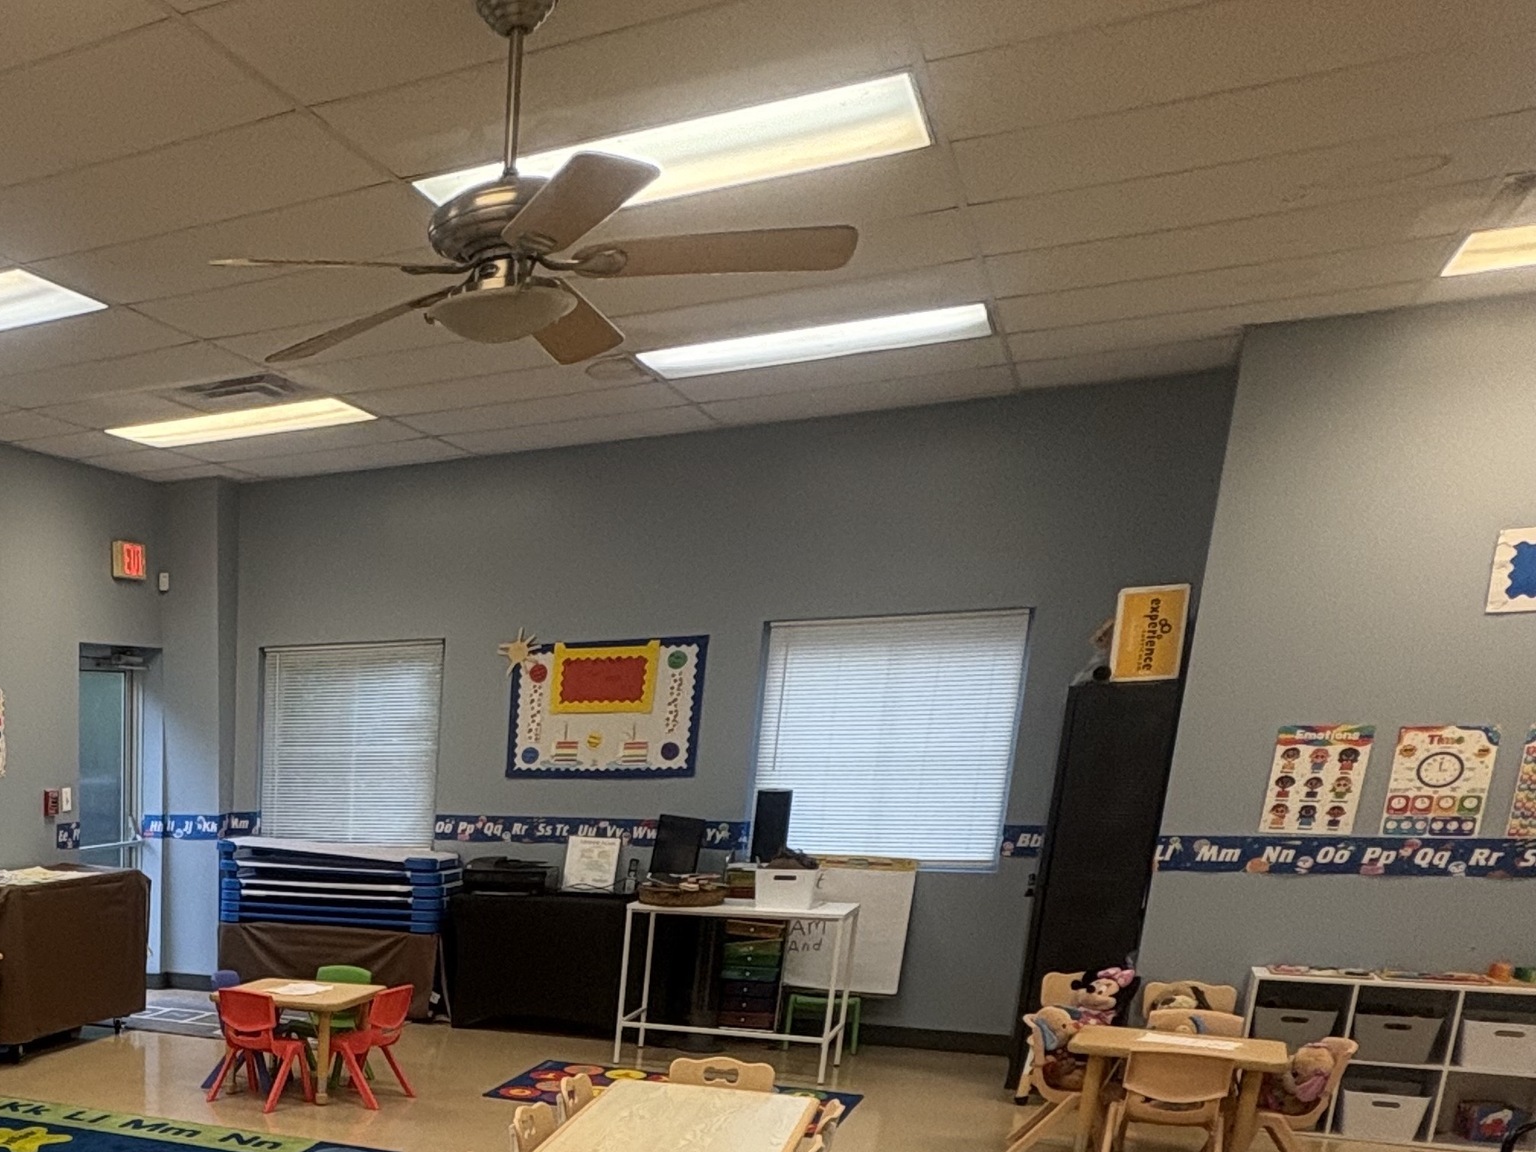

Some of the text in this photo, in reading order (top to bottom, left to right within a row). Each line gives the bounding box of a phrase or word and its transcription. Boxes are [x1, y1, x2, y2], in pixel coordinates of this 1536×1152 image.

[1142, 598, 1163, 671] experience
[1295, 729, 1361, 741] Emotions
[1427, 734, 1465, 746] Time
[434, 818, 452, 834] Oo
[457, 820, 475, 838] Pp
[483, 821, 502, 838] Qq
[511, 821, 528, 836] Rr
[536, 822, 553, 837] Ss
[555, 823, 570, 837] Tt
[577, 824, 598, 837] Uu
[605, 825, 624, 839] Vv
[1016, 832, 1043, 849] Bb
[1194, 844, 1242, 863] Mm
[1261, 845, 1296, 864] Nn
[1316, 846, 1352, 864] Oo
[1361, 846, 1397, 868] Pp
[1414, 846, 1452, 869] Qq
[1468, 847, 1505, 867] Rr
[788, 938, 823, 952] And
[62, 1109, 111, 1124] Ll
[118, 1117, 203, 1138] Mm
[218, 1131, 283, 1151] Nn
